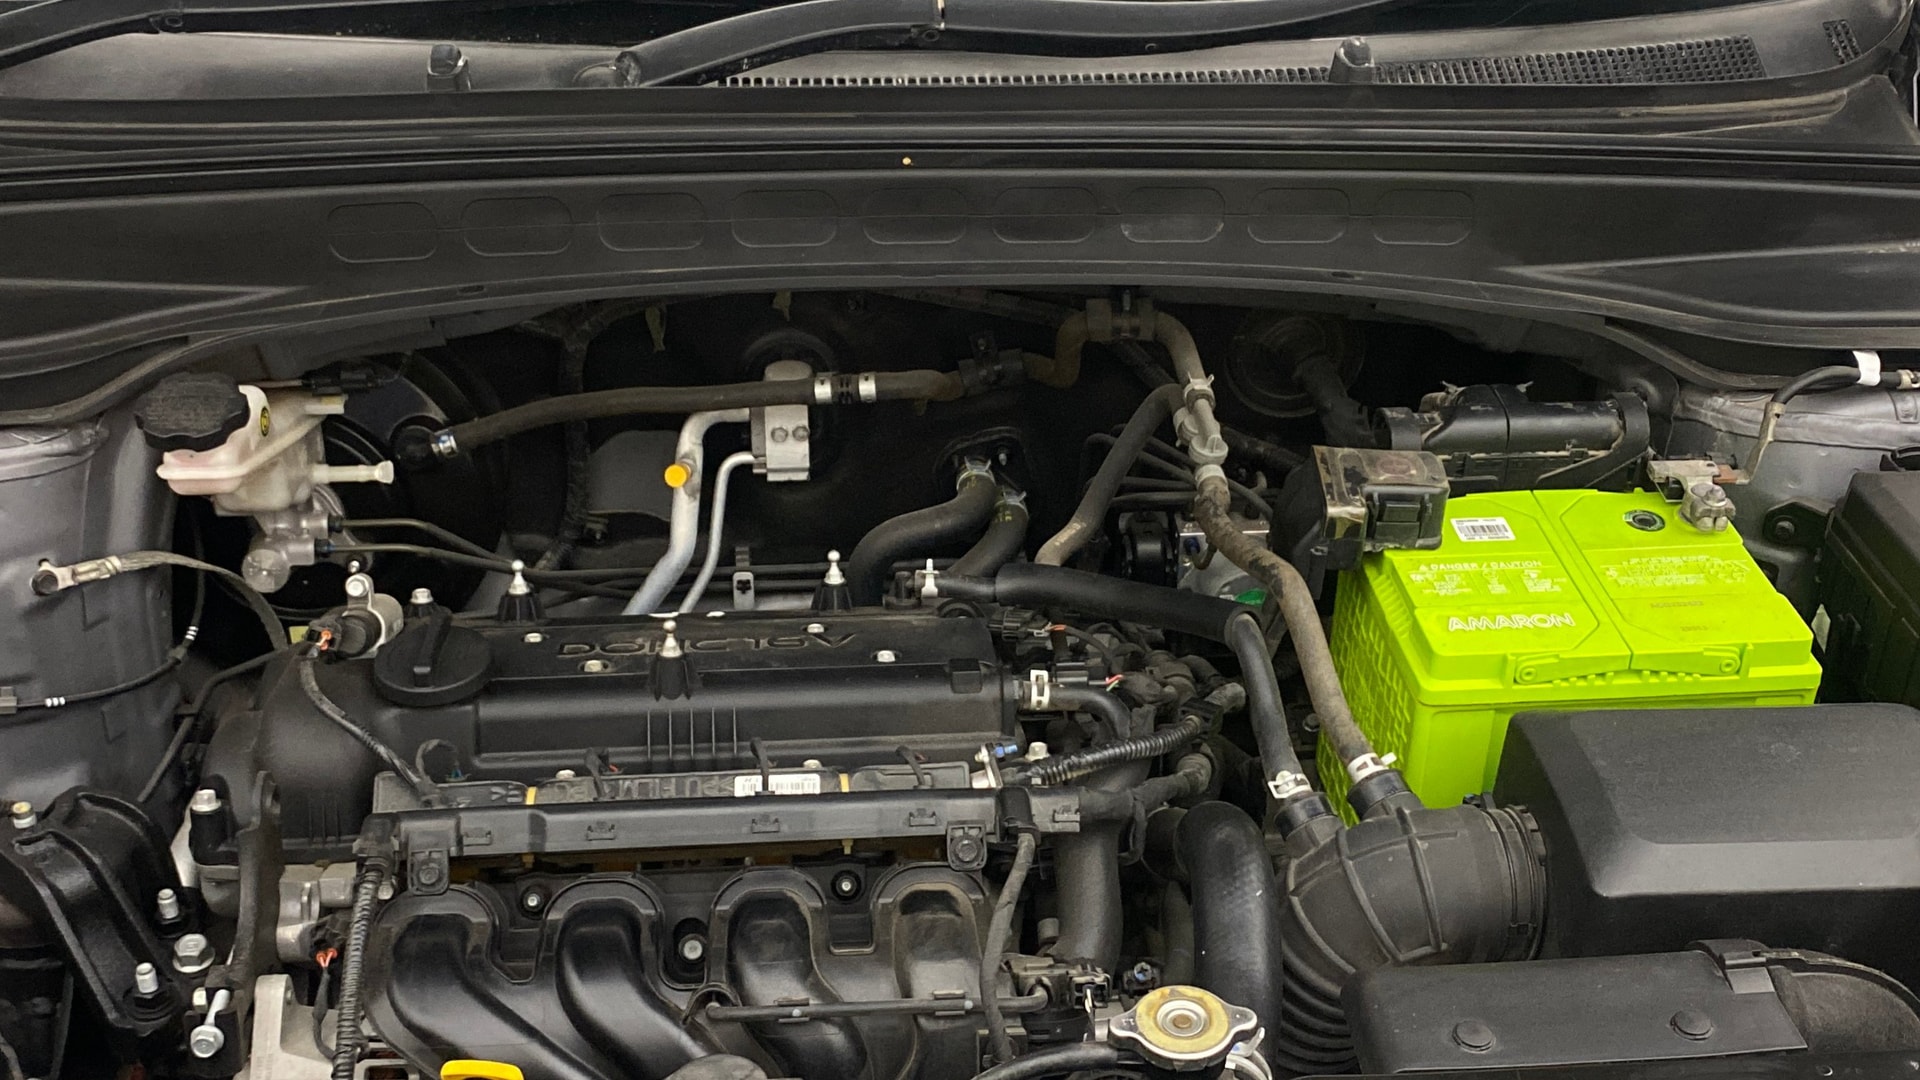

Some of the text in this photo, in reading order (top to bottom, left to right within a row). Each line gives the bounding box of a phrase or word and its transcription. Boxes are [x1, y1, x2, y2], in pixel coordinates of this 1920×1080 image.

[1431, 562, 1478, 572] DANGER
[1490, 560, 1542, 570] CAUTION
[1448, 612, 1577, 632] AMARON
